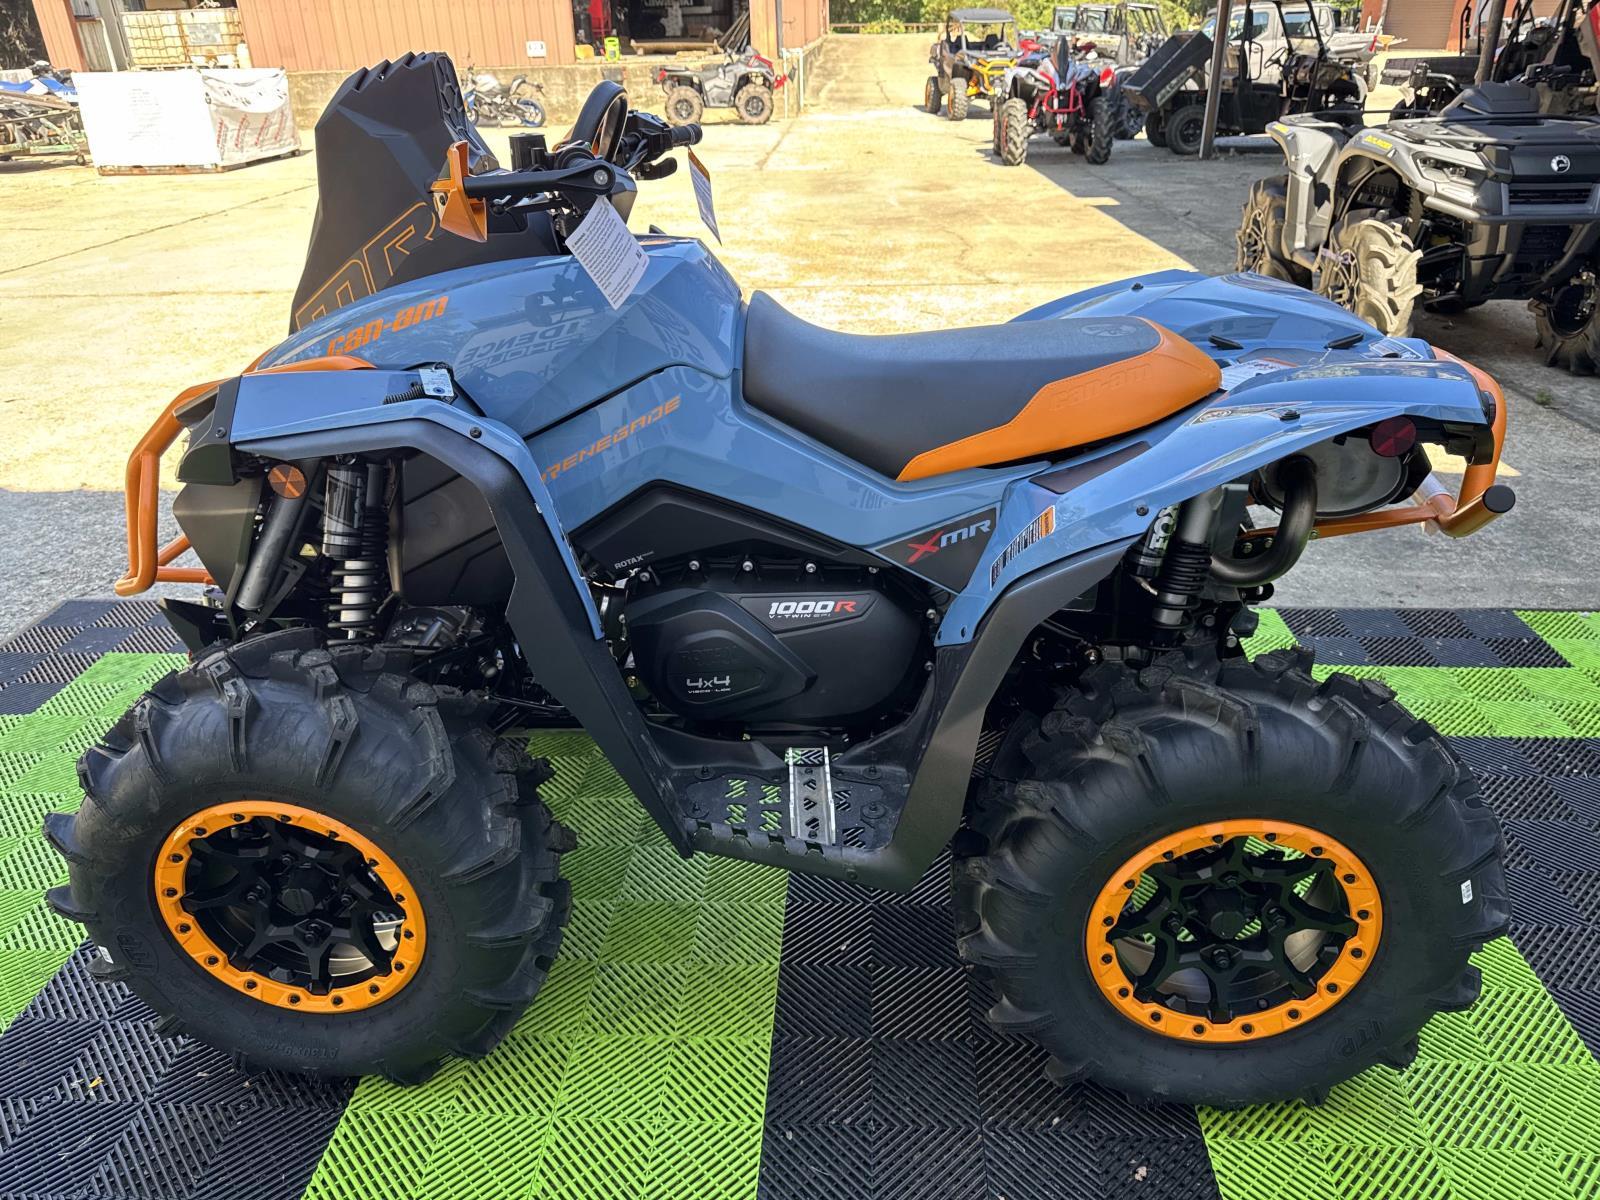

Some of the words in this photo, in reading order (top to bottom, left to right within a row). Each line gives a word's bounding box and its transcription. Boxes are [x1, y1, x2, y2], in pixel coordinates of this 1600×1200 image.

[326, 295, 449, 358] can-am
[541, 394, 682, 484] RENEGADE
[614, 555, 644, 570] ROTAX
[769, 600, 857, 615] 1000R
